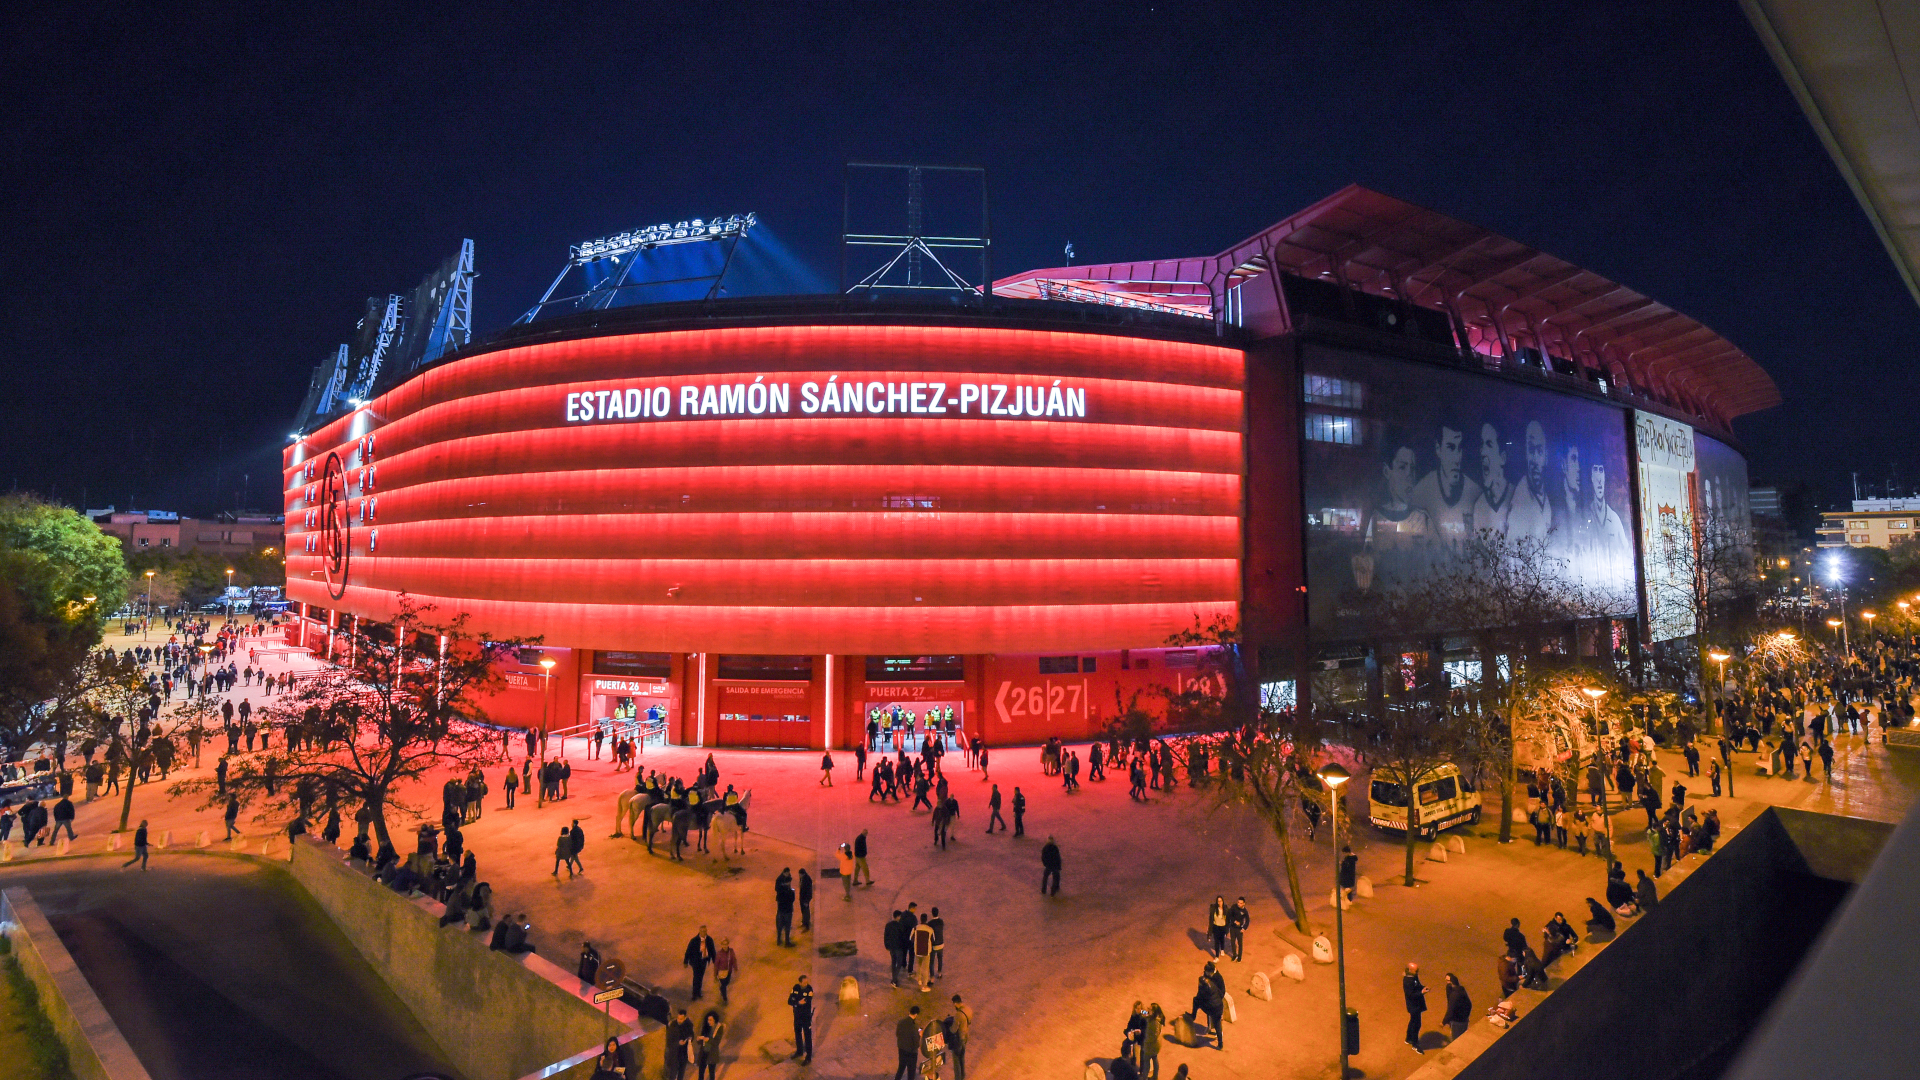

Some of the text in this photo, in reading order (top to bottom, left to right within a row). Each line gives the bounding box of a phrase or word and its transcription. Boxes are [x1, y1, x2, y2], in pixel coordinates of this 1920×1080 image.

[567, 375, 1085, 422] ESTADIO RAMÓN SÁNCHEZ-PIZJUÁN
[505, 674, 528, 686] PUERTA
[595, 680, 640, 691] PUERTA 26
[726, 686, 749, 694] SALIDA
[760, 687, 804, 695] EMERGENCIA
[870, 687, 925, 697] PUERTA 27
[1011, 685, 1082, 716] 26 27
